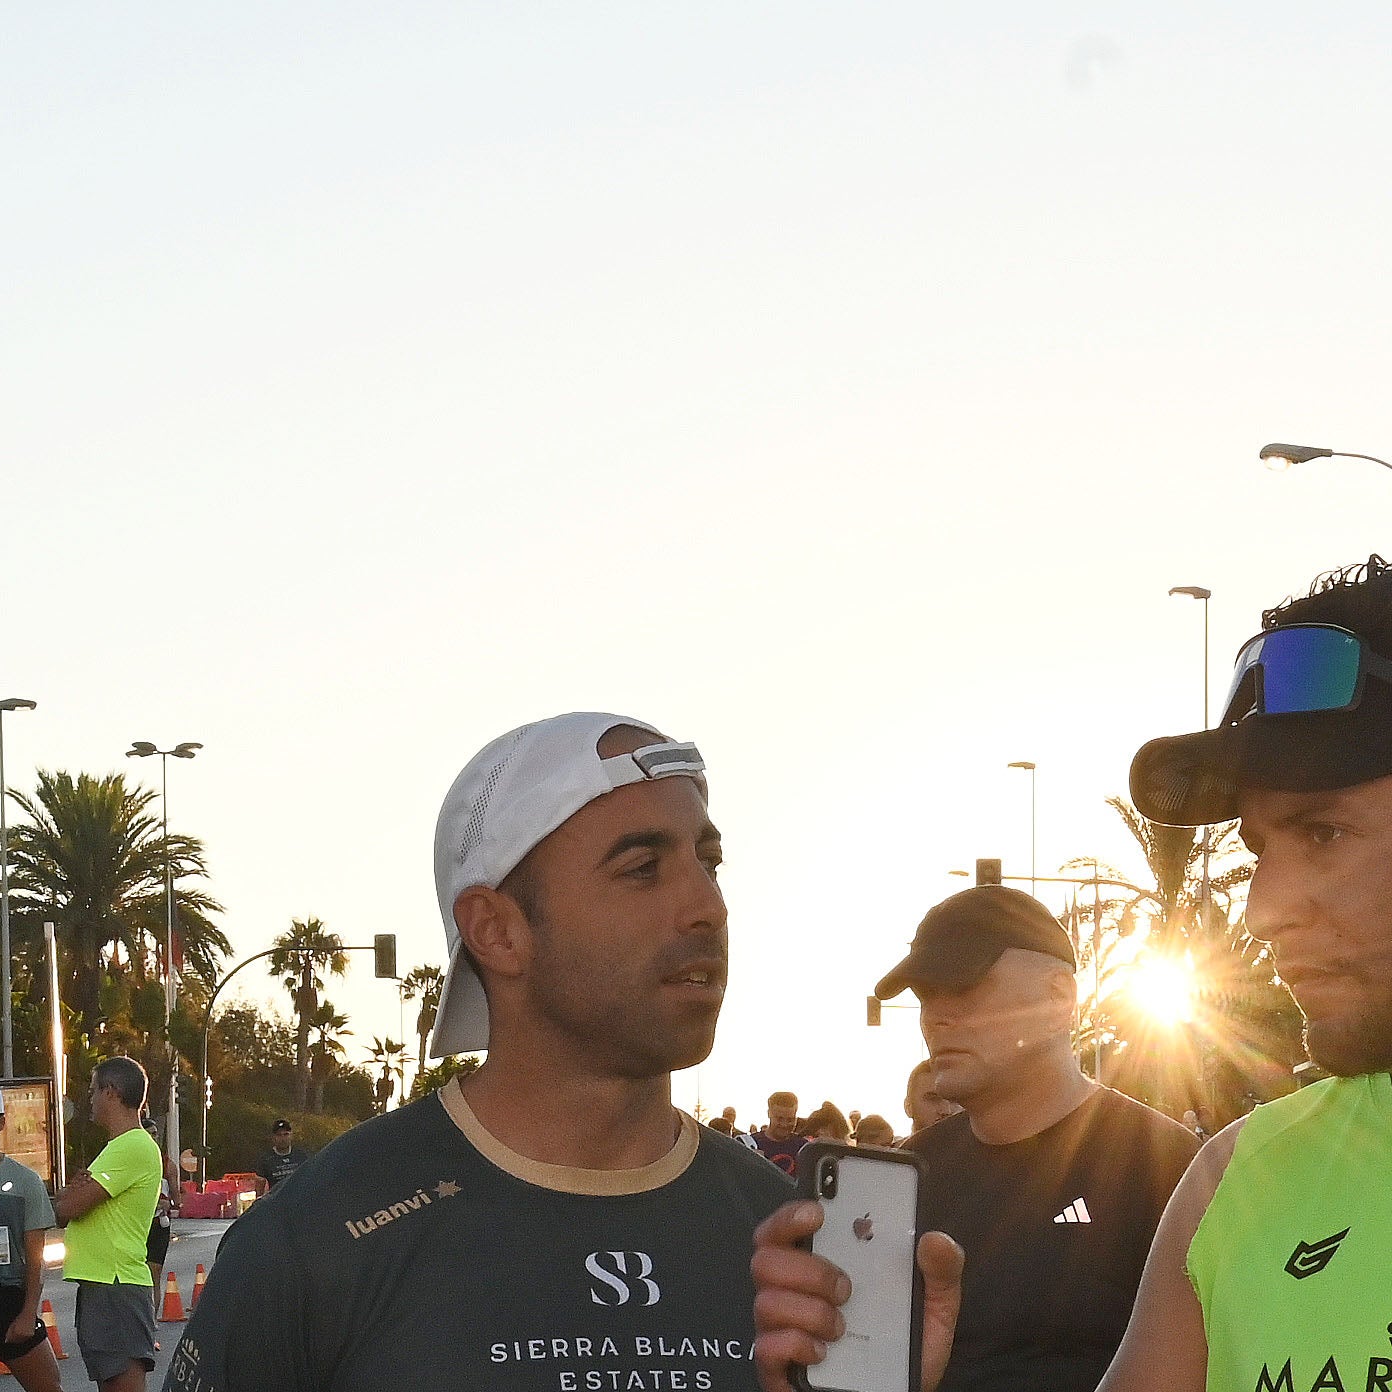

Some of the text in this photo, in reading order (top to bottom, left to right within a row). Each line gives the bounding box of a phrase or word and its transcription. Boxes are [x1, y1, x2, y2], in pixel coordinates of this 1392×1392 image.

[345, 1188, 433, 1240] luanvi
[490, 1337, 620, 1363] SIERRA
[559, 1370, 713, 1392] ESTATES
